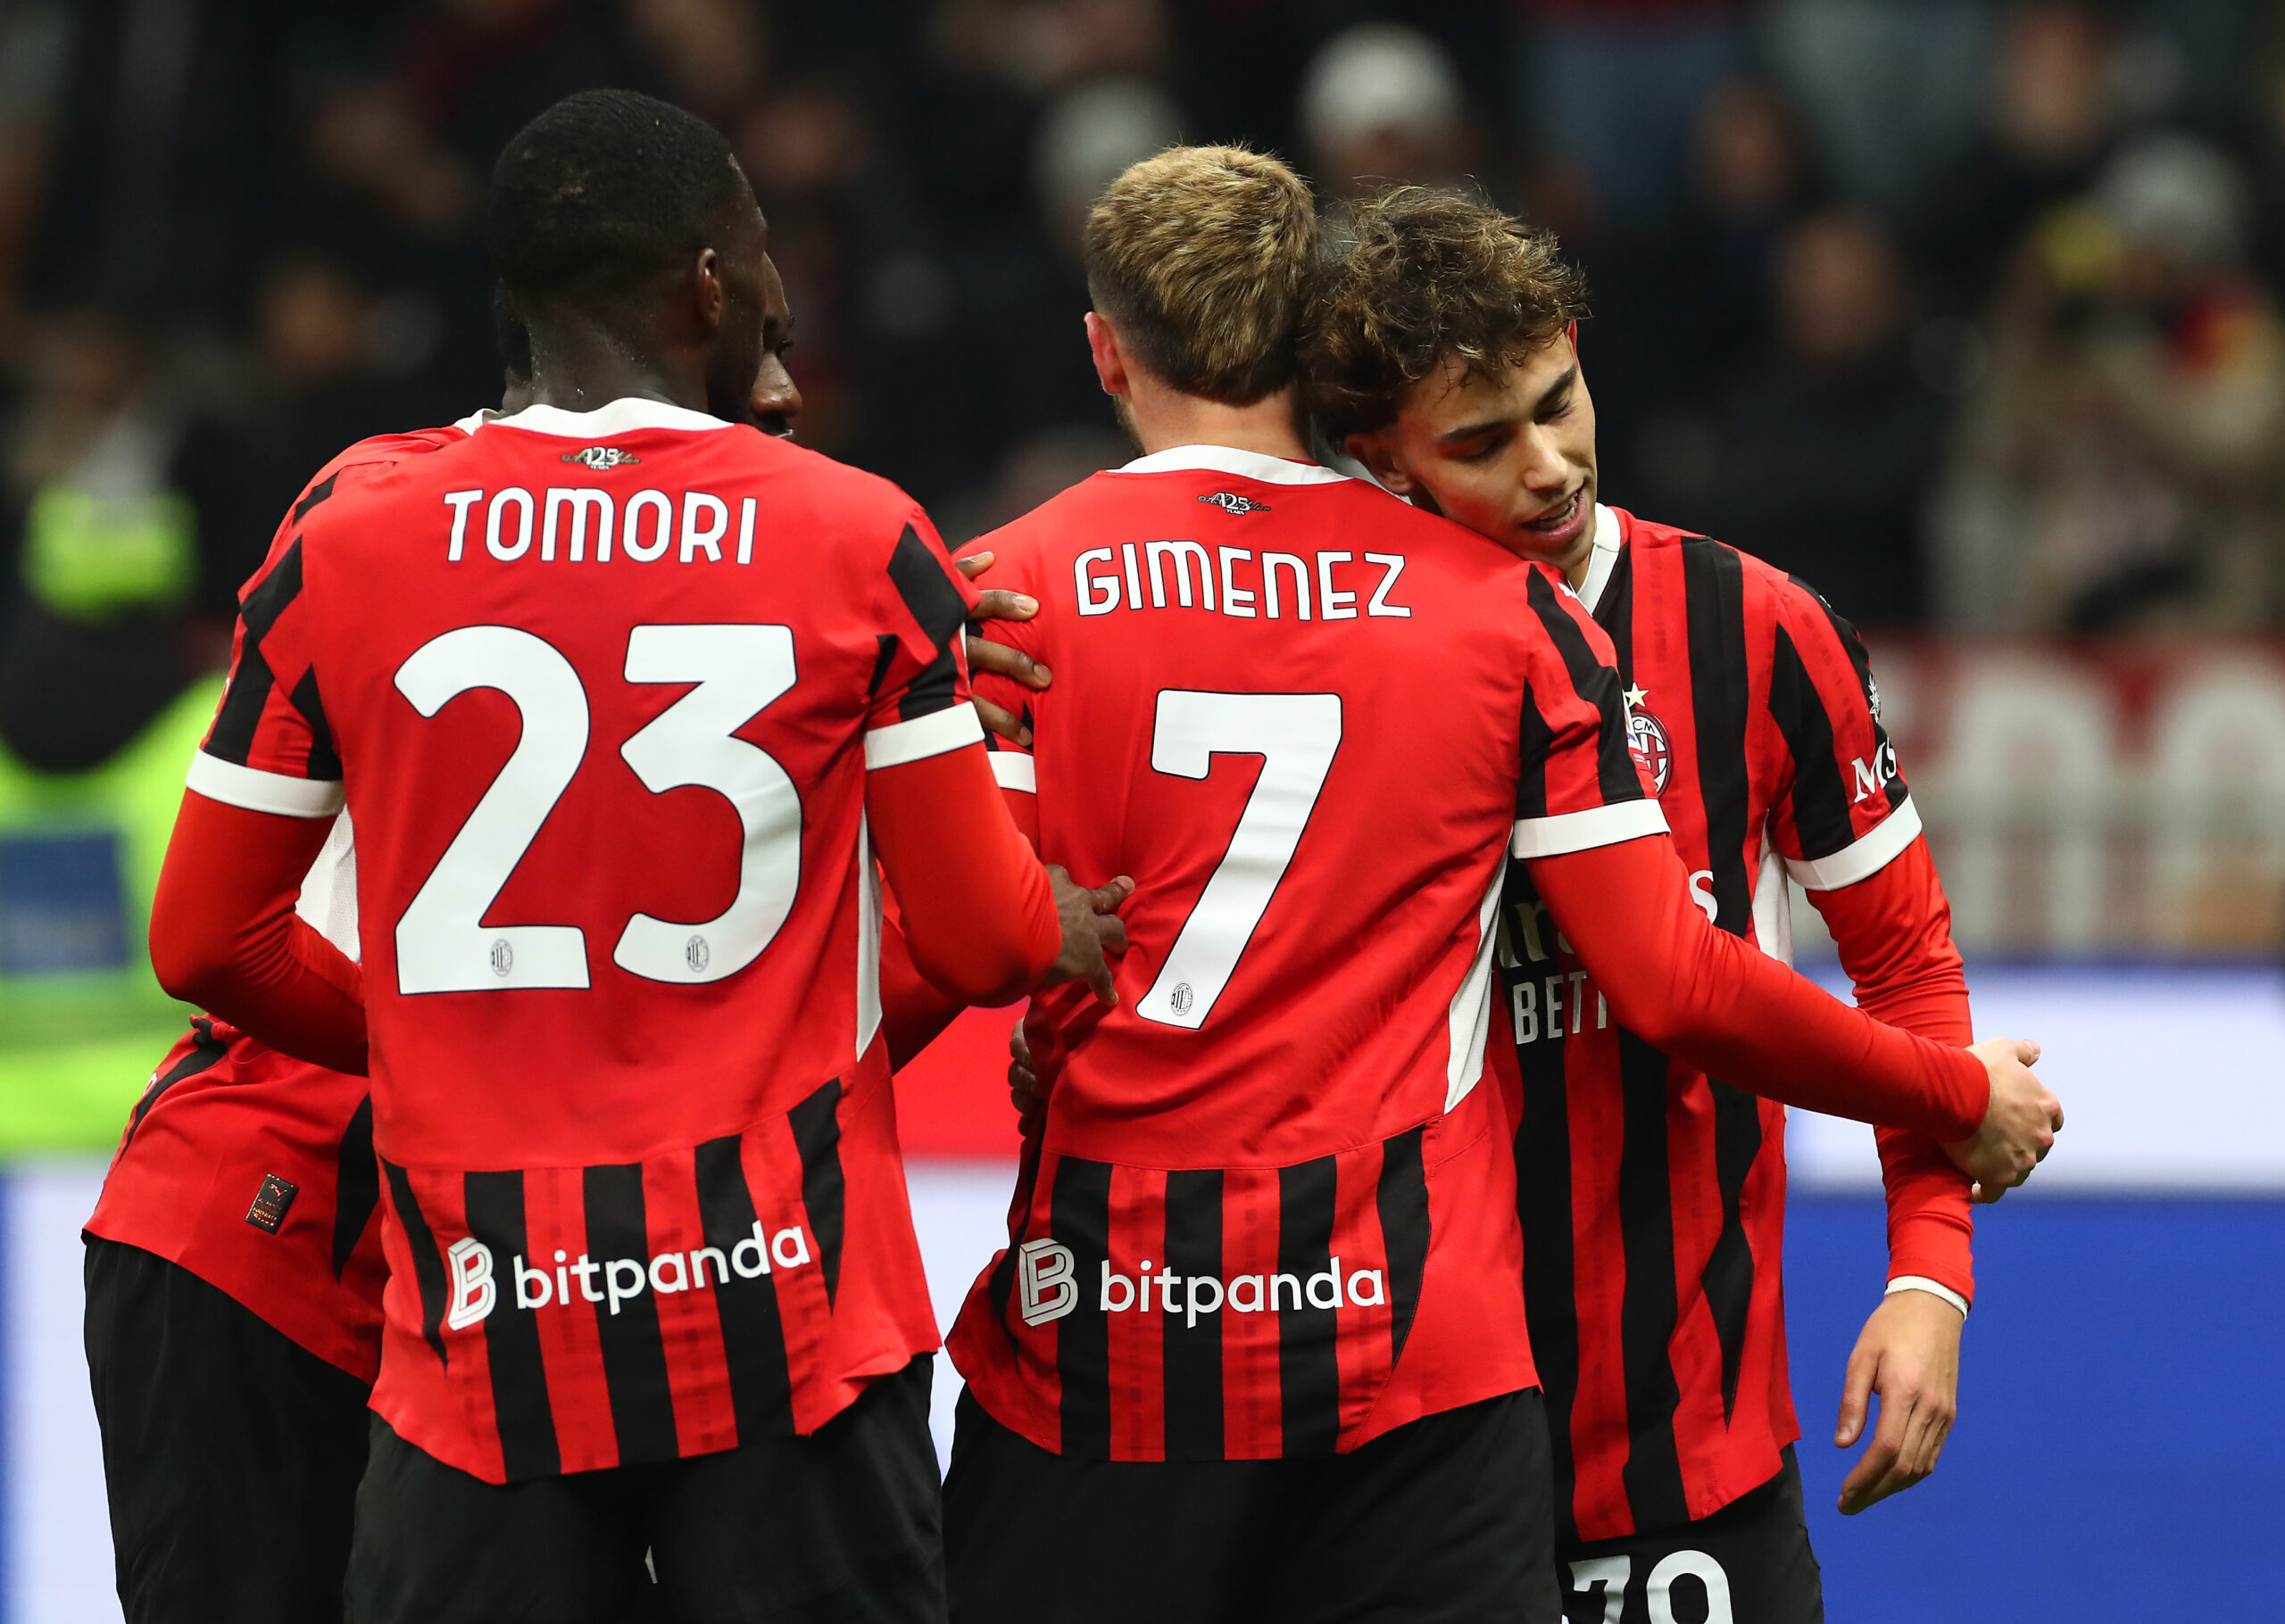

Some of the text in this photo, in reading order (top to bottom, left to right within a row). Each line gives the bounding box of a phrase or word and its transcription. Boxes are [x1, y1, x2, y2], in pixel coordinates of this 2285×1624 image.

[585, 446, 619, 466] 125
[444, 486, 757, 565] TOMORI
[1216, 492, 1251, 511] 125
[1073, 540, 1412, 621] GIMENEZ
[393, 623, 803, 995] 23
[1135, 688, 1342, 1030] 7
[513, 1220, 810, 1315] bitpanda
[1100, 1255, 1385, 1329] bitpanda
